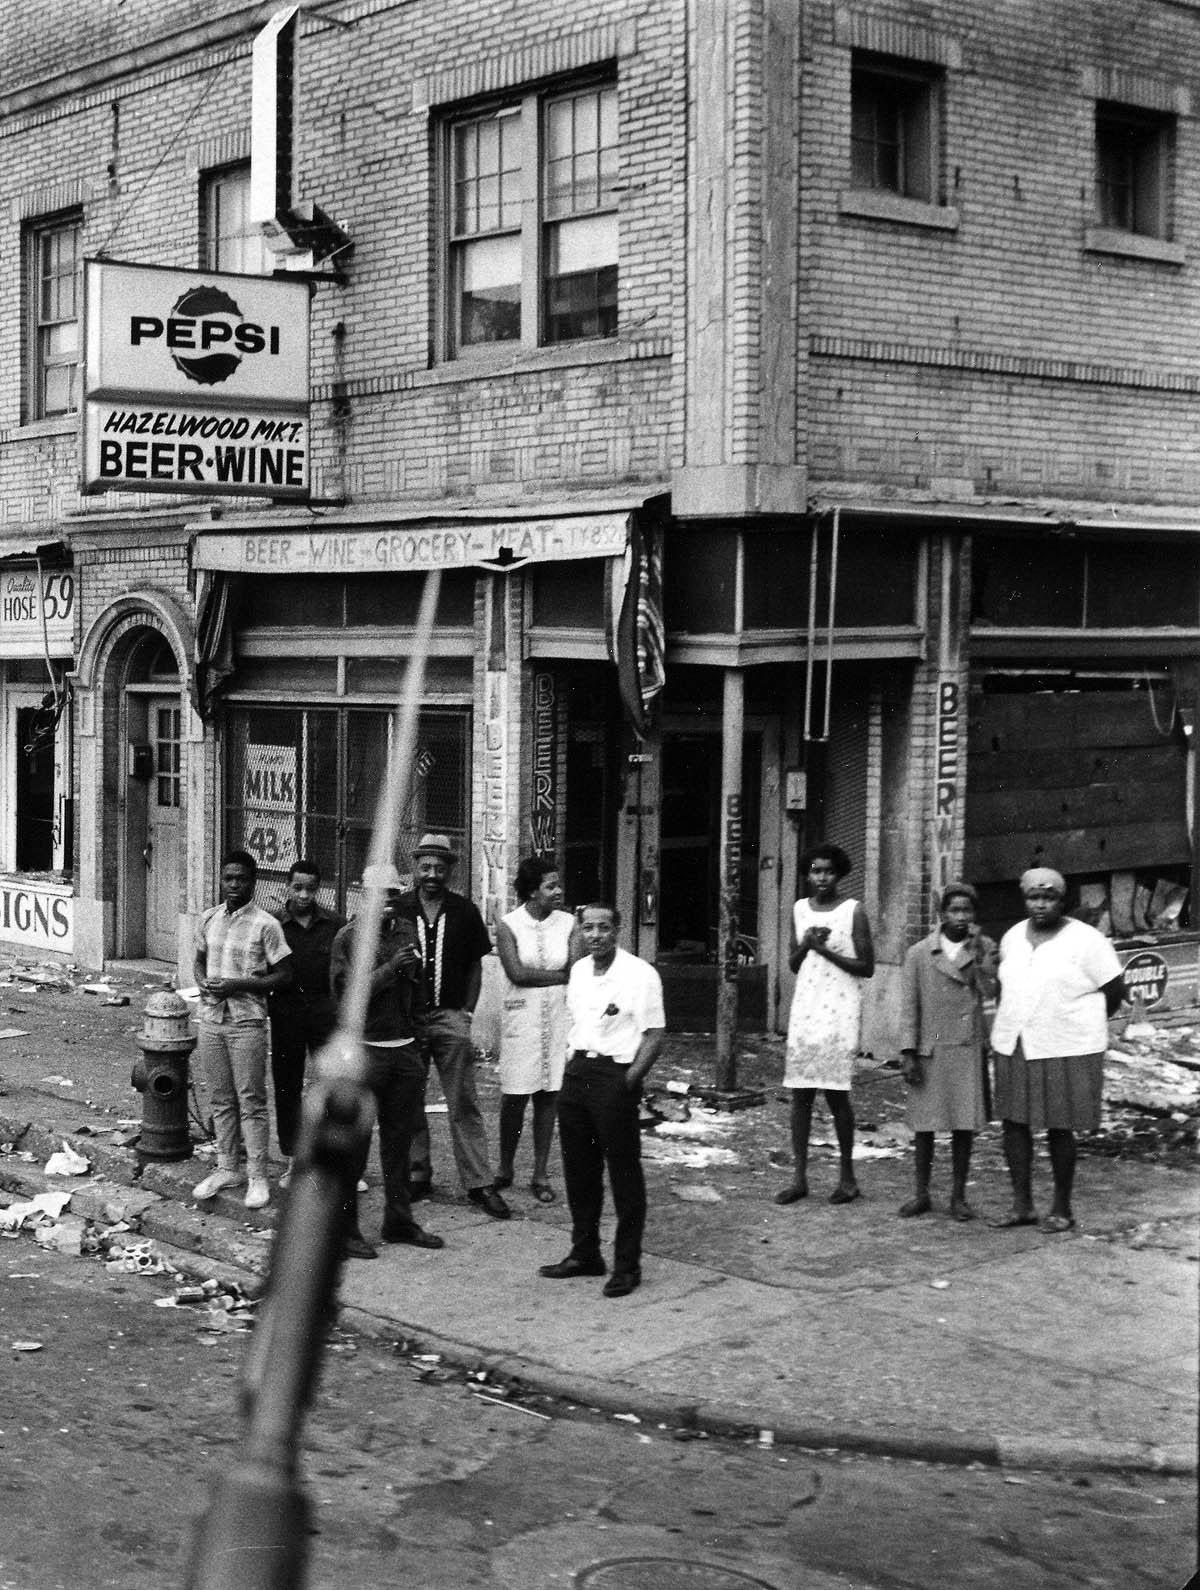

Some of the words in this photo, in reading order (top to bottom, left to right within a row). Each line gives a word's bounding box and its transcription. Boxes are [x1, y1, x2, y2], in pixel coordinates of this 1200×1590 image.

[130, 315, 280, 355] PEPSI
[103, 410, 250, 440] HAZELWOOD
[250, 419, 304, 443] MKT.
[244, 537, 293, 565] BEER
[308, 539, 361, 566] WINE
[3, 595, 38, 622] HOSE
[534, 672, 555, 811] BEER
[936, 681, 959, 816] BEER
[246, 768, 293, 804] MILK
[1123, 964, 1166, 985] DOUBLE
